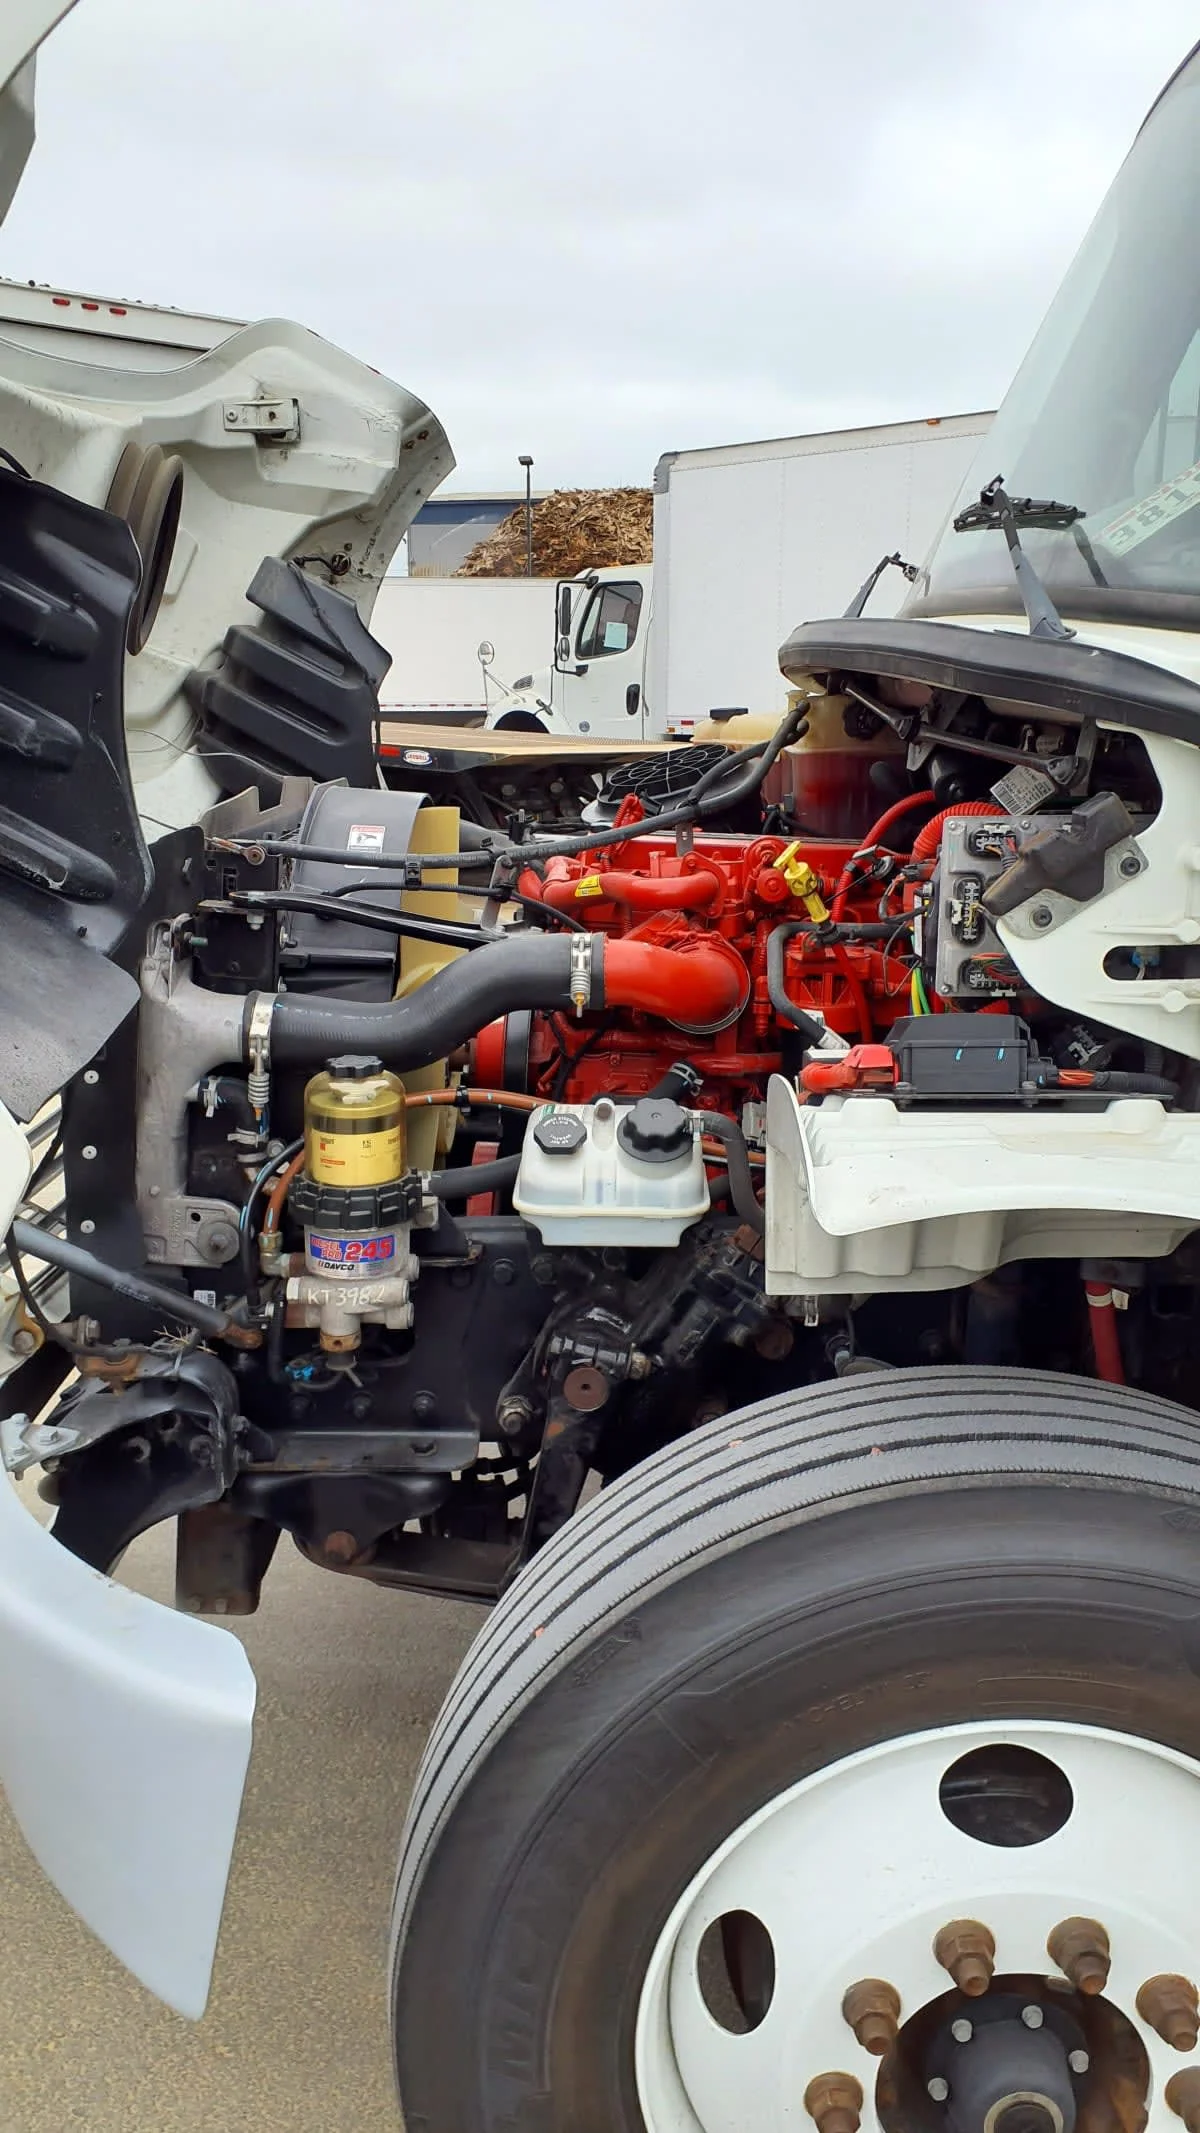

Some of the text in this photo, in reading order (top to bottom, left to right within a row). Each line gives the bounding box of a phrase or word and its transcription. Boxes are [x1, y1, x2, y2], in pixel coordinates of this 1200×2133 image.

[1108, 474, 1200, 546] 381
[344, 1238, 393, 1262] 245
[324, 1261, 355, 1271] DAVCO
